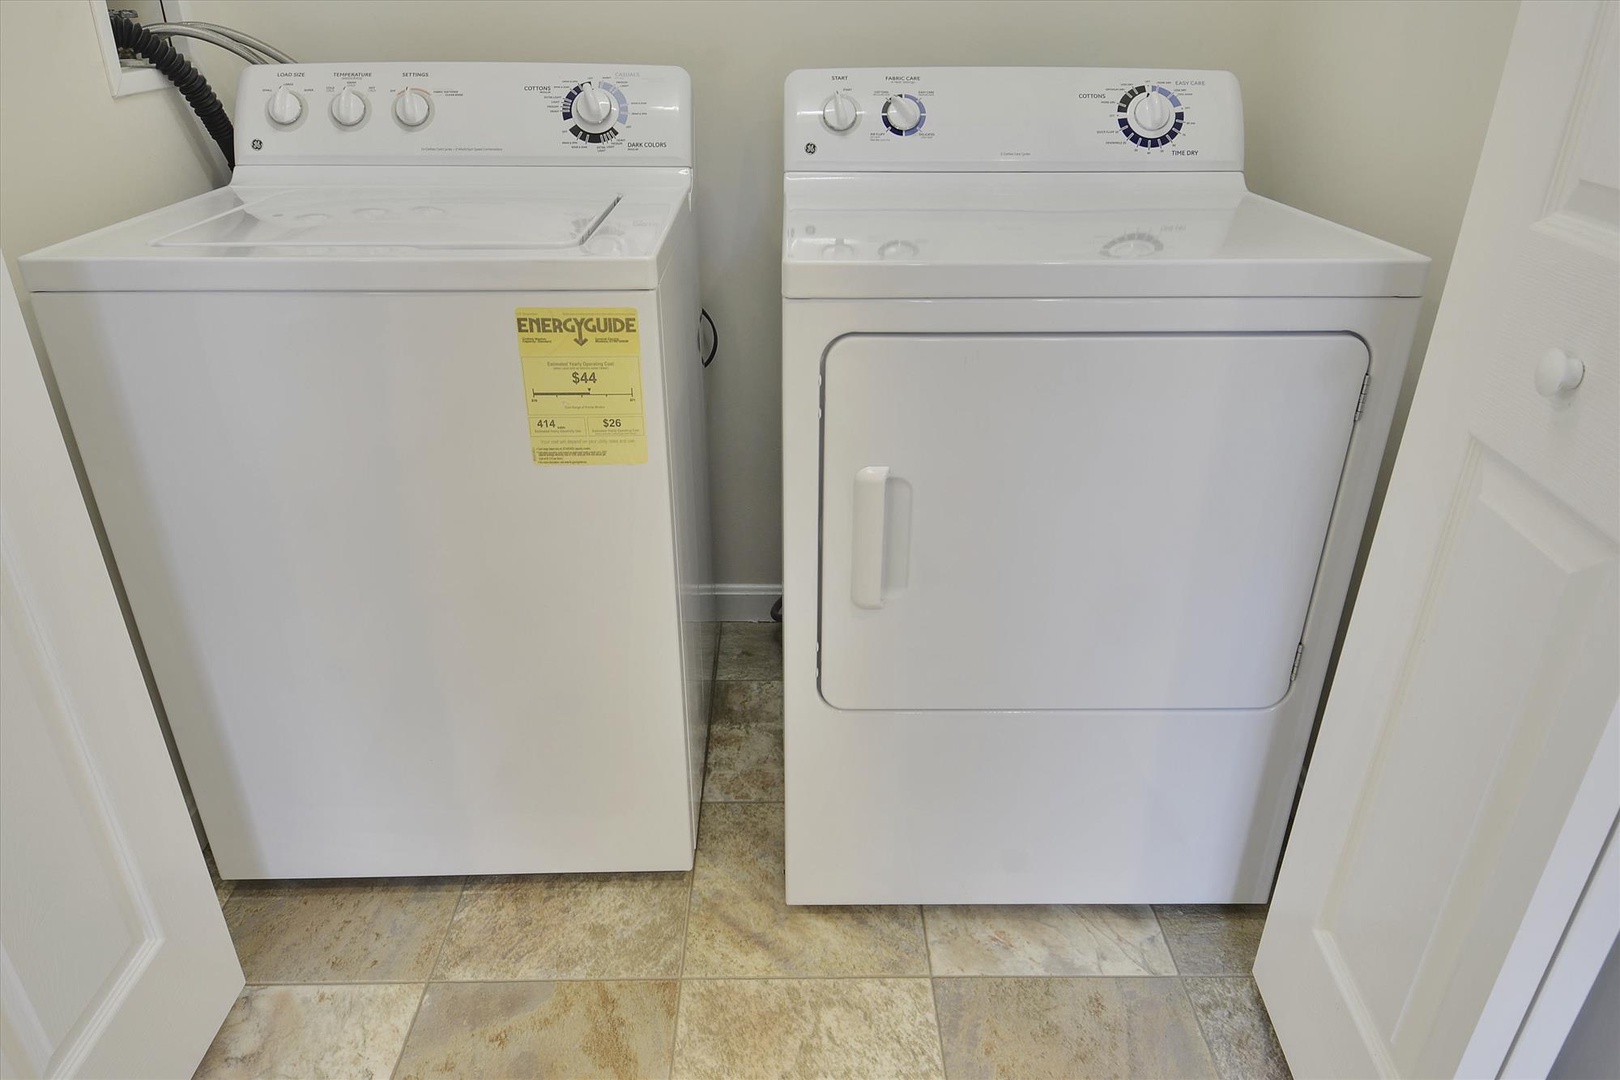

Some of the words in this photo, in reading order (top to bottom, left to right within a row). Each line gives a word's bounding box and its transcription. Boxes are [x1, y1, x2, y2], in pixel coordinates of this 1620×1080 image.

[517, 318, 636, 333] ENERGYGUIDE
[572, 371, 597, 385] $44
[537, 419, 555, 428] 414
[603, 419, 621, 428] $26
